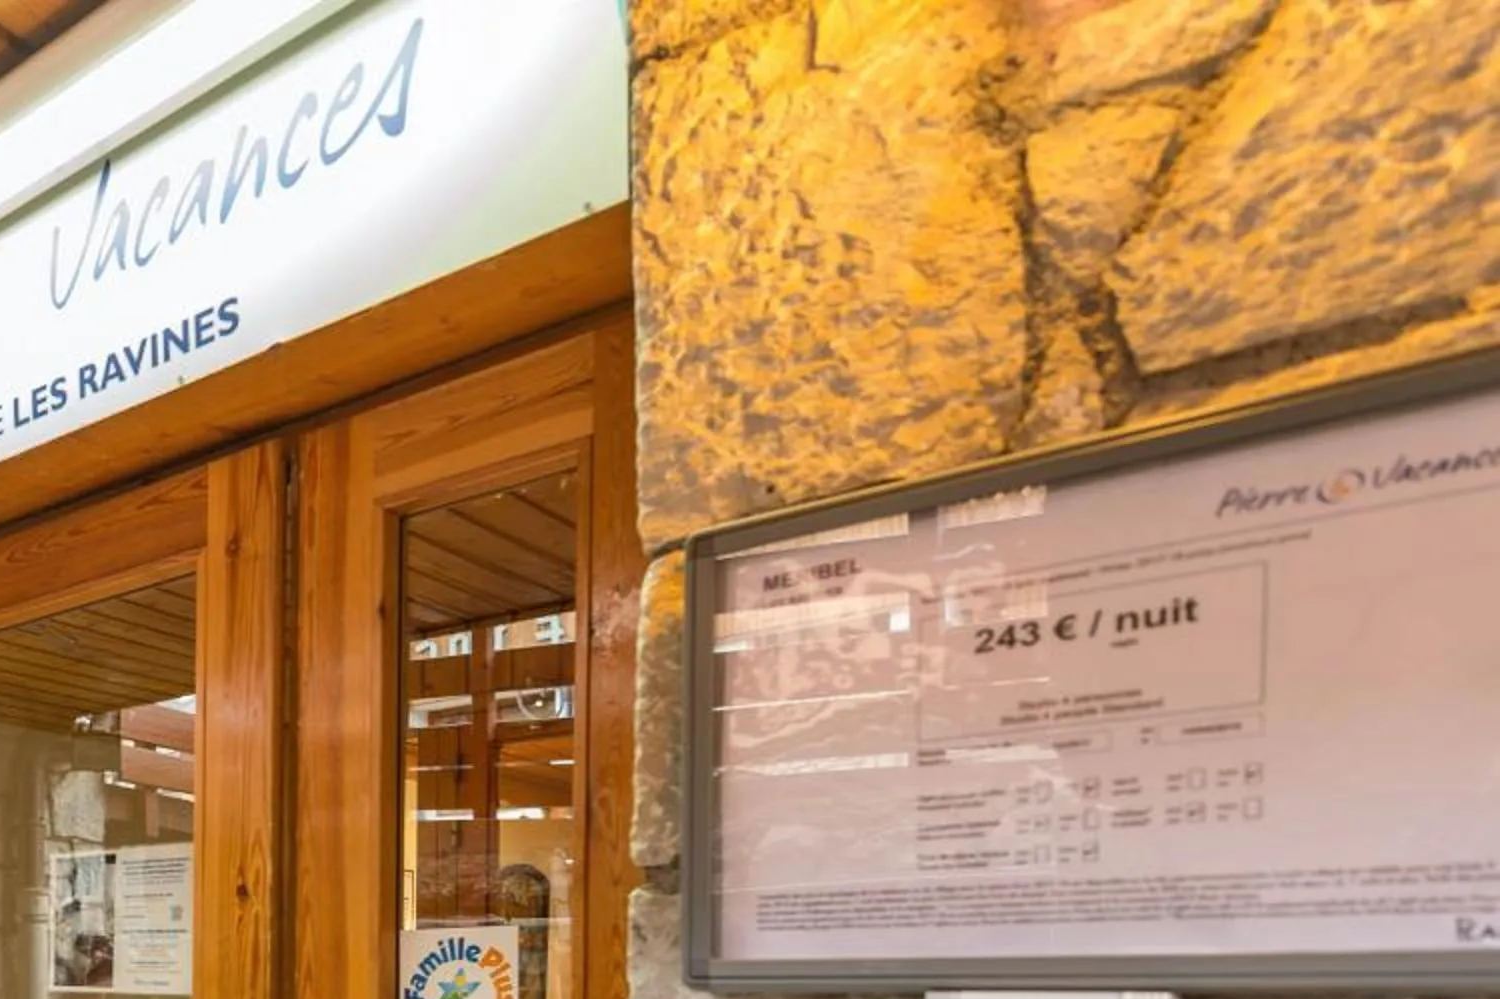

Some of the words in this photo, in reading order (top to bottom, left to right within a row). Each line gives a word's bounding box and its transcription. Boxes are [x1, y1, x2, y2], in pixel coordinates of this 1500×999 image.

[50, 17, 425, 310] Vacances
[12, 377, 68, 428] LES
[78, 298, 240, 399] RAVINES
[974, 621, 1041, 654] 243
[1053, 614, 1077, 641] €
[1089, 609, 1102, 638] /
[1116, 597, 1199, 633] nuit
